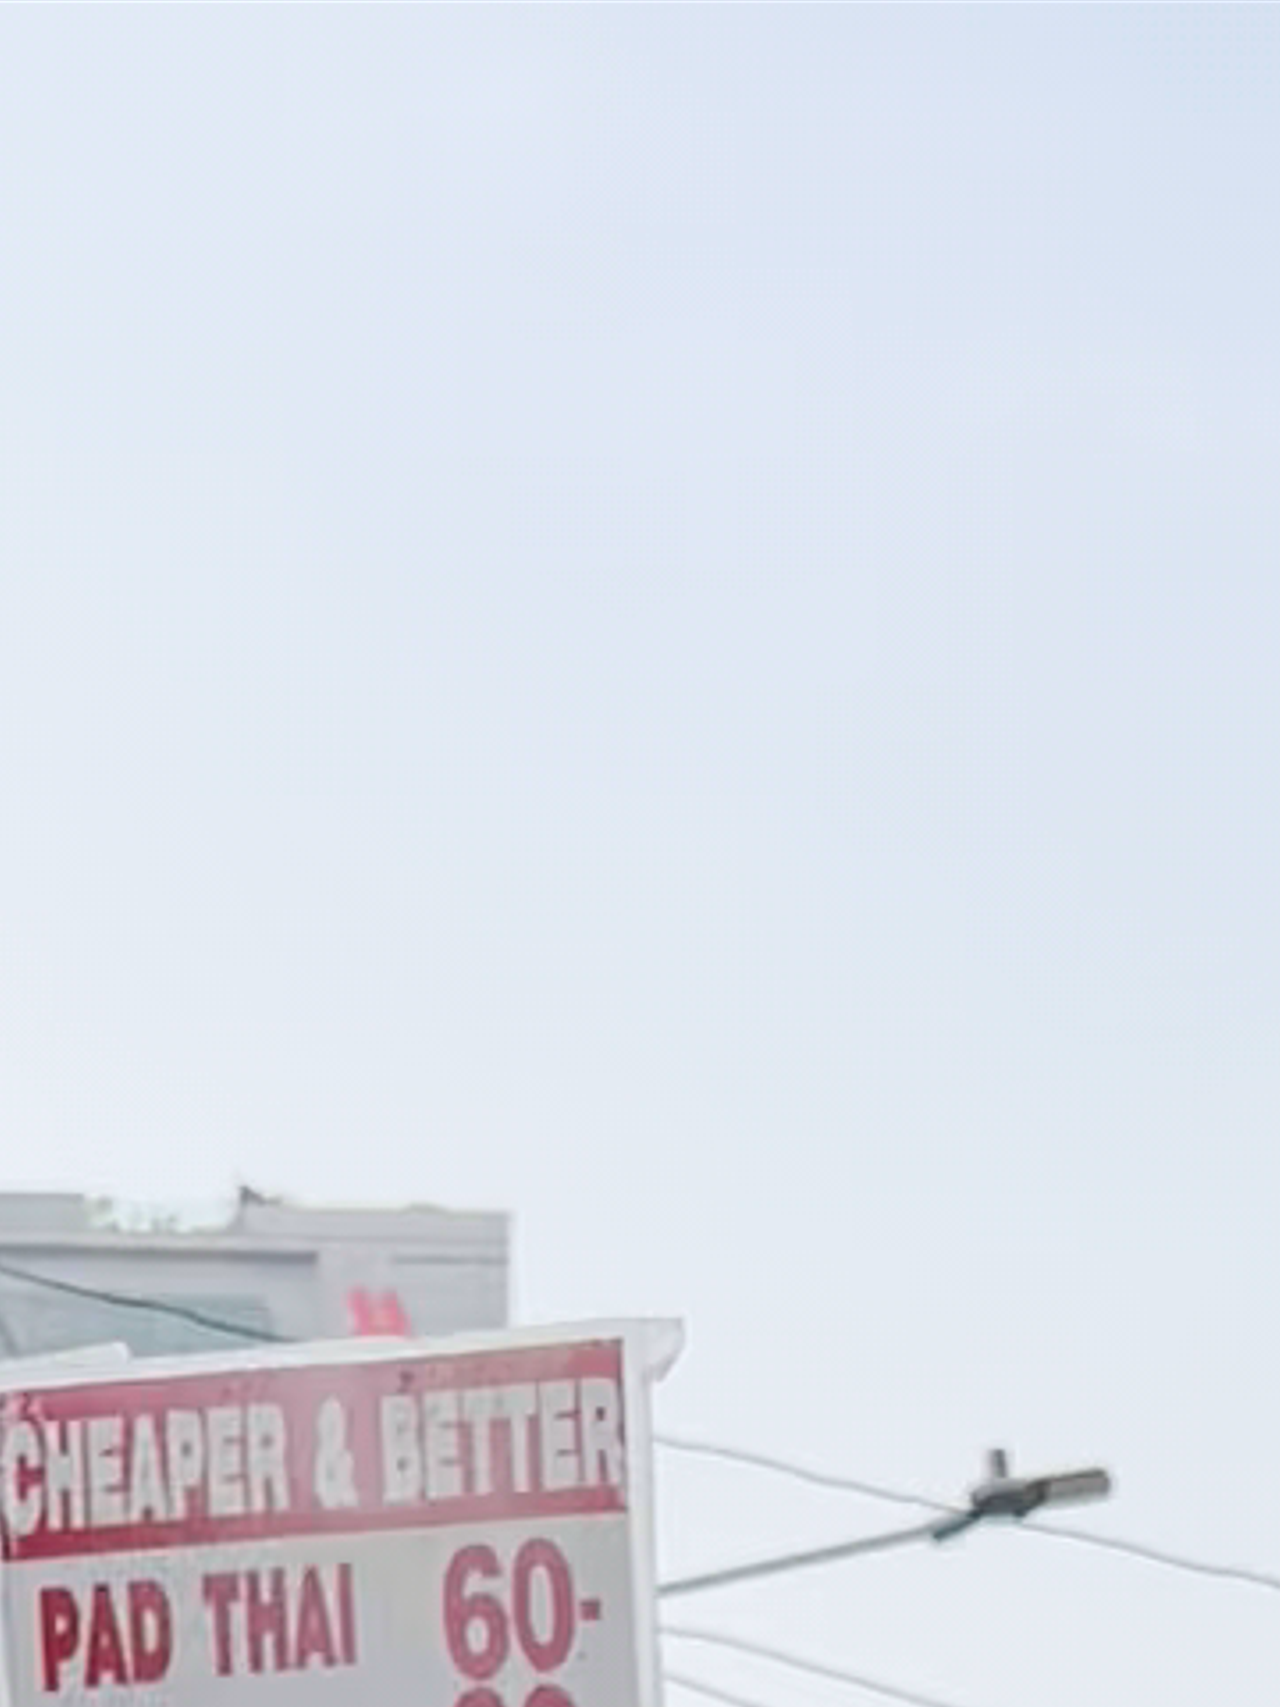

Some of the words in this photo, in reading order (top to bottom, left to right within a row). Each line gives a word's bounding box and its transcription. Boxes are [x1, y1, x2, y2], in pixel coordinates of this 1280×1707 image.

[0, 1400, 291, 1534] CHEAPER
[315, 1400, 358, 1509] &
[381, 1377, 623, 1505] BETTER
[38, 1578, 173, 1693] PAD
[202, 1561, 357, 1677] THAI
